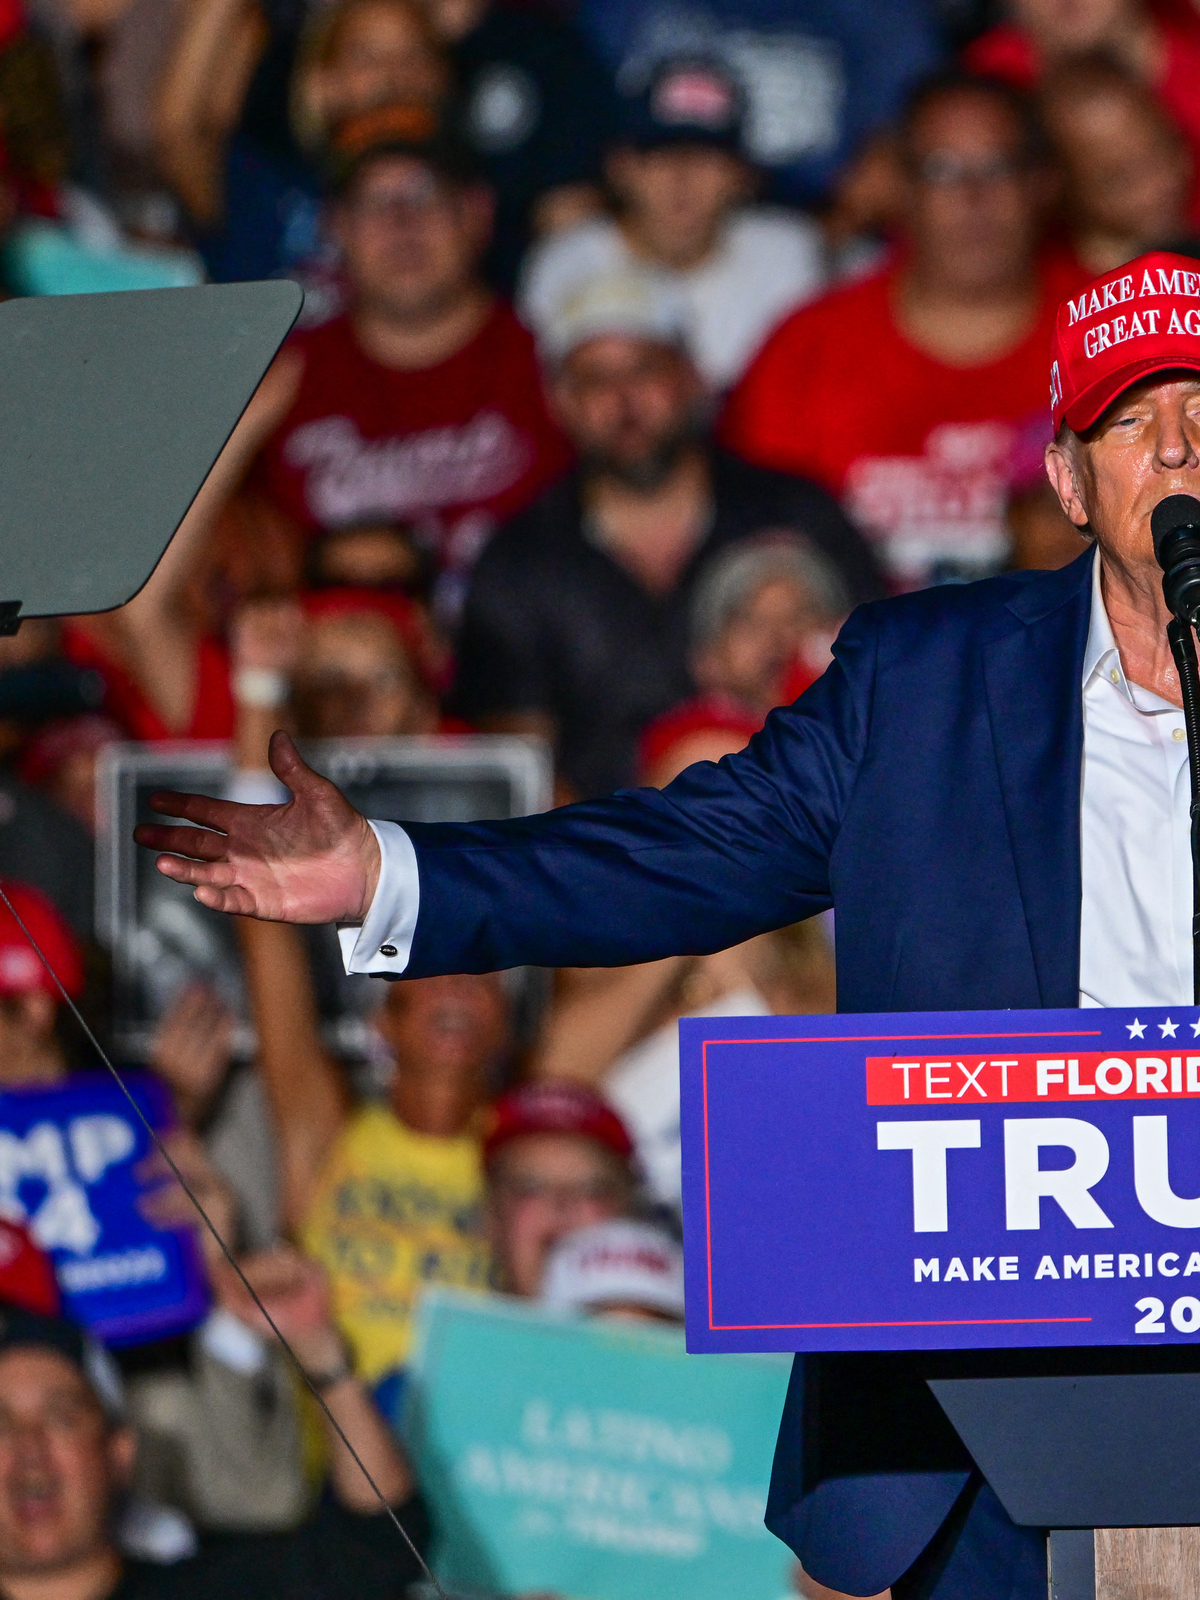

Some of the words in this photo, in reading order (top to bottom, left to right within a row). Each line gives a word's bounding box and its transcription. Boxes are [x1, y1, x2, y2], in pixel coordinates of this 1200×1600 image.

[1066, 273, 1135, 327] MAKE
[1083, 308, 1161, 359] GREAT
[890, 1060, 1019, 1099] TEXT
[913, 1256, 1020, 1283] MAKE
